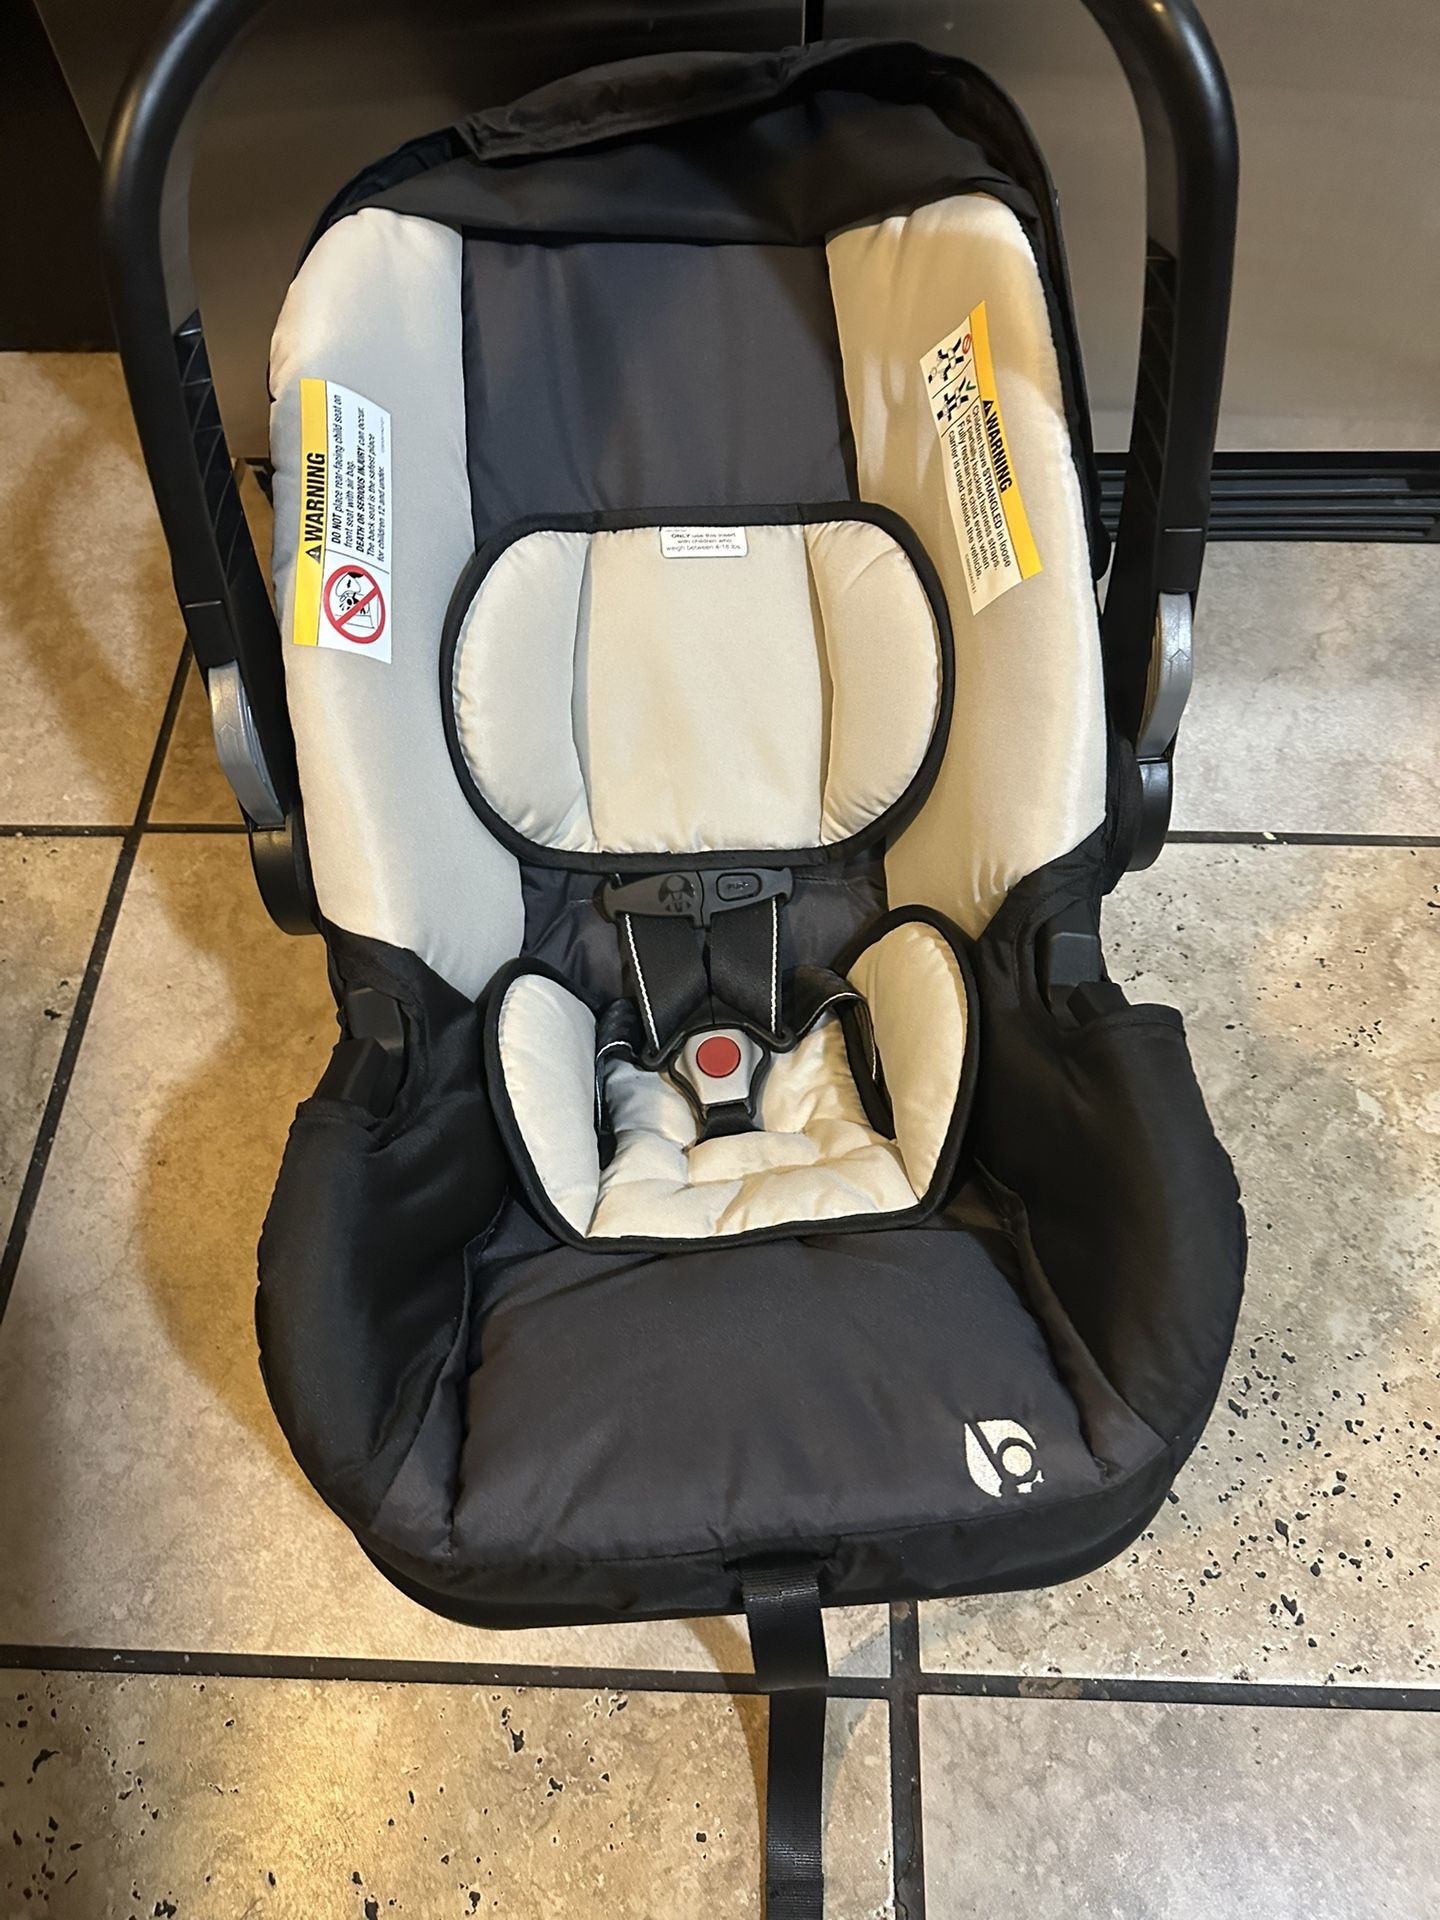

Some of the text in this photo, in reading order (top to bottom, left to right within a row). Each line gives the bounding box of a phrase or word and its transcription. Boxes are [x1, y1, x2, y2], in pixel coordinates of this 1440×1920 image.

[368, 433, 376, 456] place
[949, 430, 958, 459] carrier
[987, 411, 1012, 493] WARNING
[332, 395, 345, 544] DO NOT place rear-facing child seat on
[357, 445, 365, 476] INJURY
[953, 460, 961, 470] is
[304, 453, 325, 541] WARNING
[345, 478, 353, 489] air
[357, 476, 365, 511] SERIOUS
[955, 470, 965, 493] used
[958, 421, 990, 569] Fully restrain the child even when
[966, 415, 1000, 570] or partially buckled harness straps.
[973, 405, 1011, 567] Children have STRANGLED in loose
[357, 513, 365, 524] OR
[378, 506, 385, 516] 12
[960, 493, 971, 527] outside
[344, 528, 353, 548] front
[356, 526, 364, 552] DEATH
[377, 518, 385, 549] children
[971, 544, 983, 580] vehicle.
